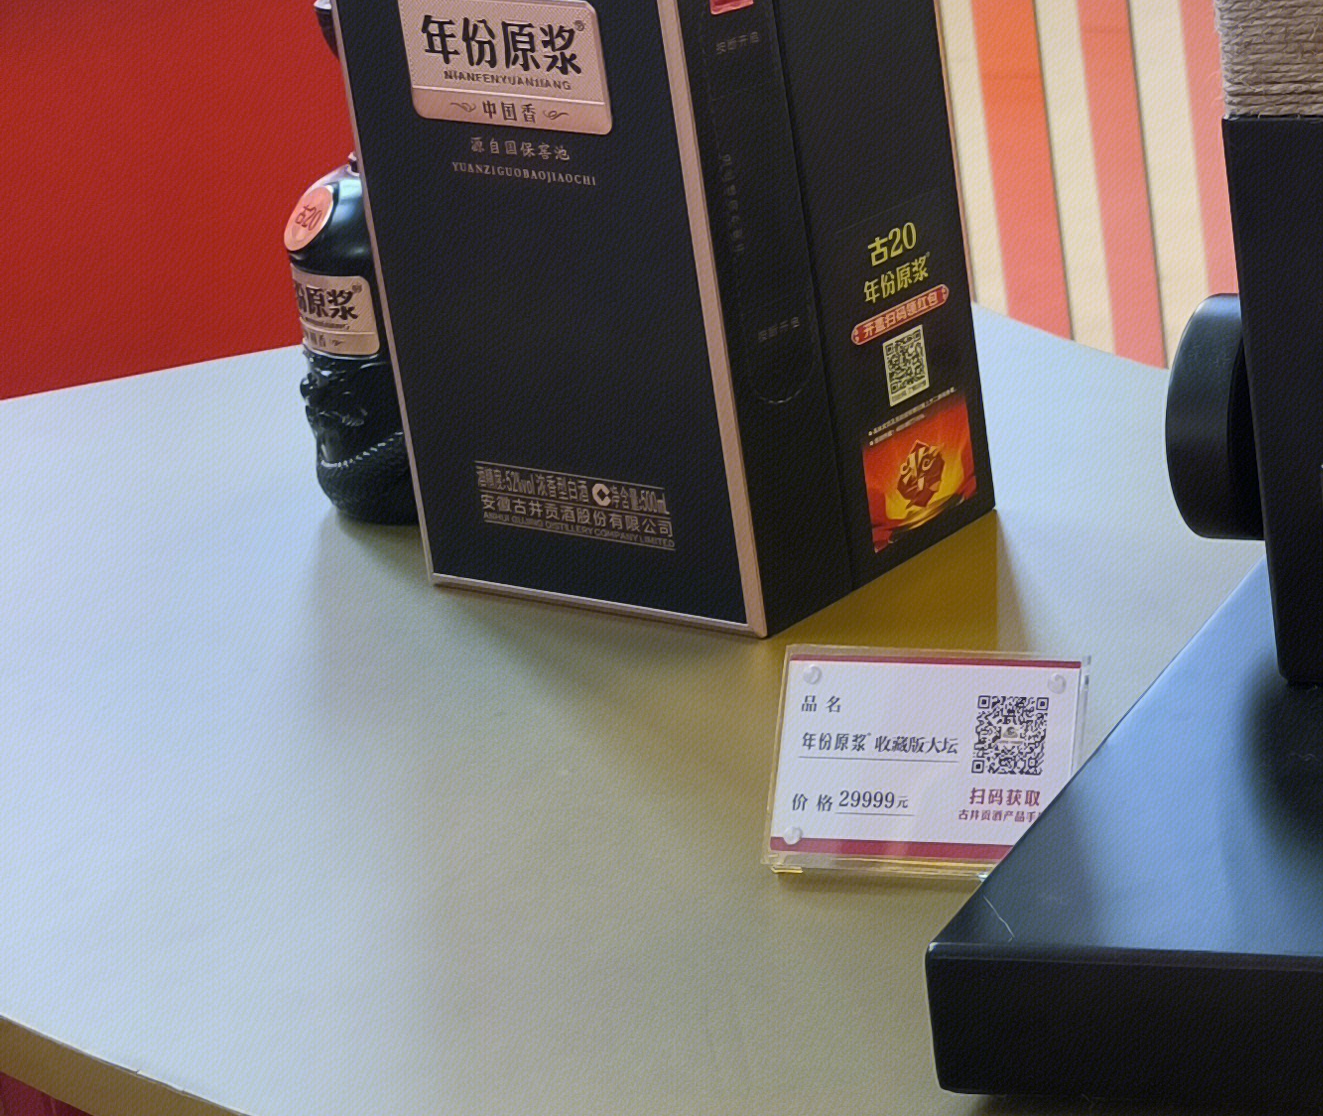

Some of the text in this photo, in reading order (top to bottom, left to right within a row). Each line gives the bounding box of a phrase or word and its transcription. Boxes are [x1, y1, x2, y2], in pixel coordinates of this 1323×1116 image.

[420, 13, 583, 76] 年份原浆
[481, 100, 538, 124] 中国香
[867, 221, 918, 268] 古20
[863, 257, 930, 305] 年份原浆
[969, 786, 1041, 807] 扫码获取
[957, 808, 1043, 823] 古井贡酒产品手
